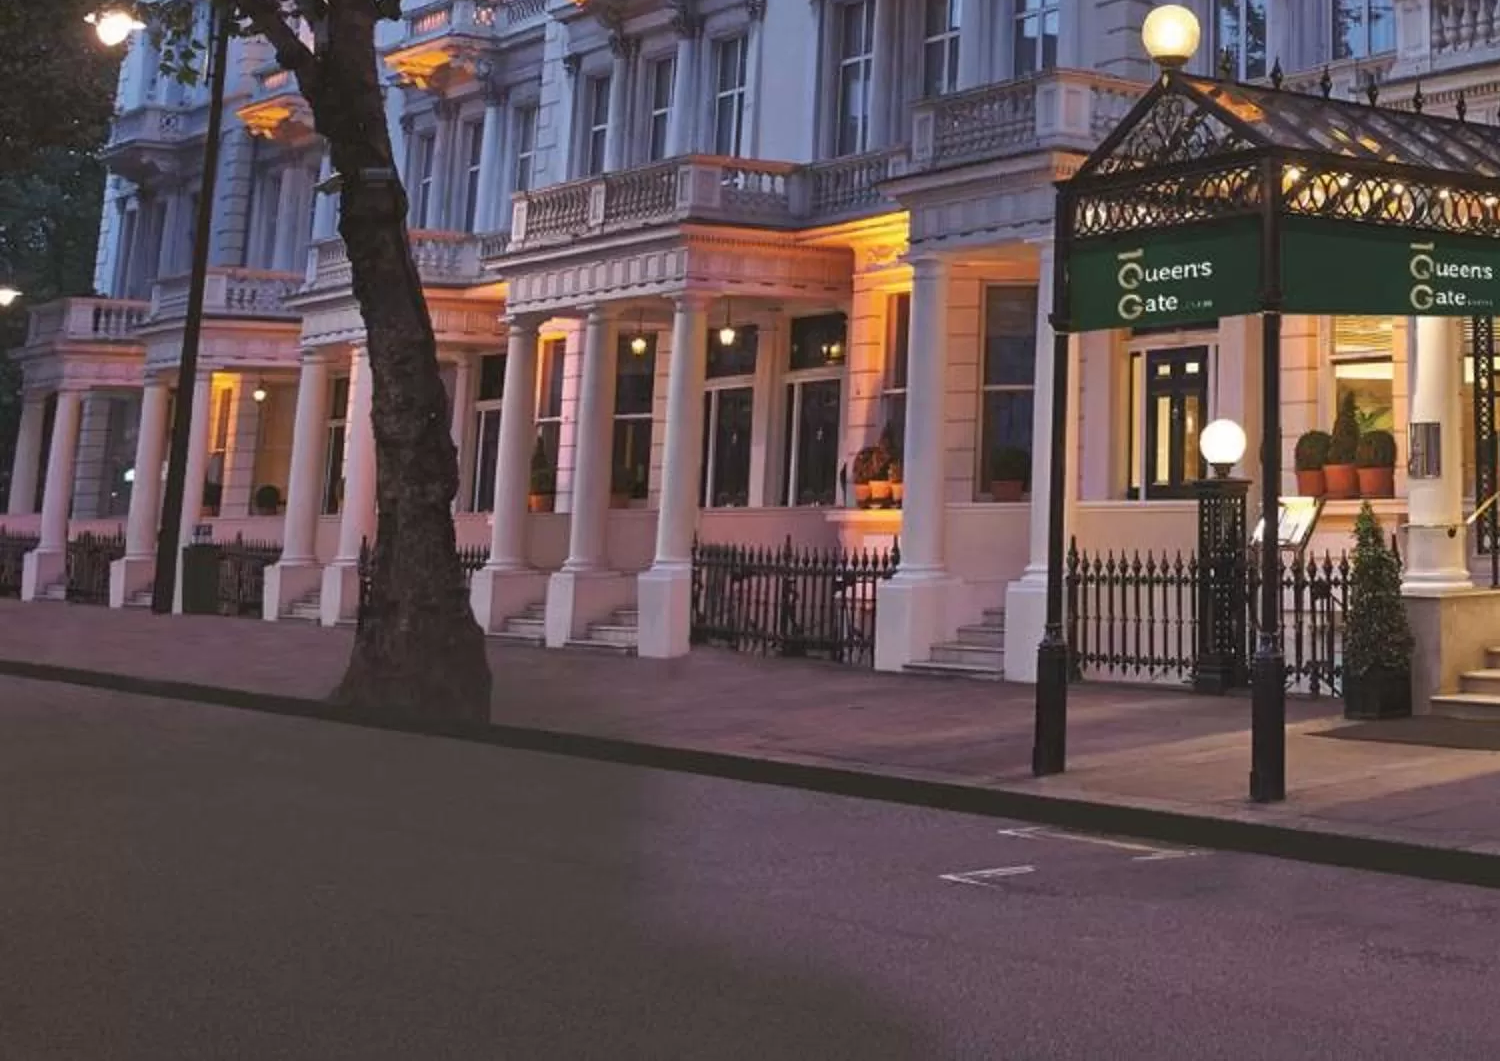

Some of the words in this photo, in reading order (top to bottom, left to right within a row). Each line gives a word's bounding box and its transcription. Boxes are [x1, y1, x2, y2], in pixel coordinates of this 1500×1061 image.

[1118, 261, 1213, 289] Queen's
[1118, 293, 1179, 320] Gate
[1410, 283, 1467, 310] Gate
